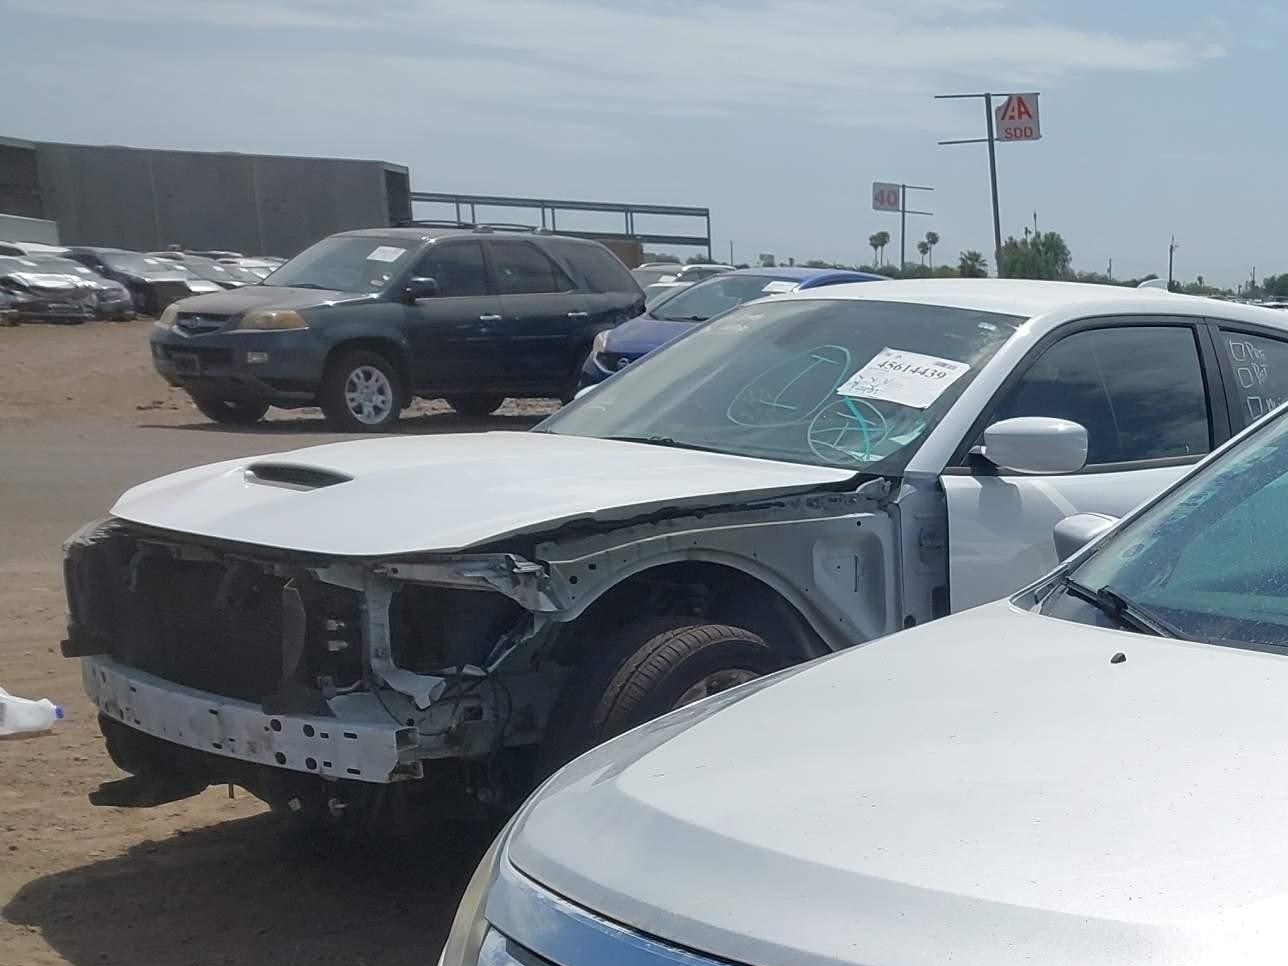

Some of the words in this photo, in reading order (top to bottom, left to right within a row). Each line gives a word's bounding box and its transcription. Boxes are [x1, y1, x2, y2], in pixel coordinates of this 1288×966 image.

[1004, 126, 1034, 139] SDD
[875, 189, 898, 207] 40
[878, 360, 947, 380] 45614439
